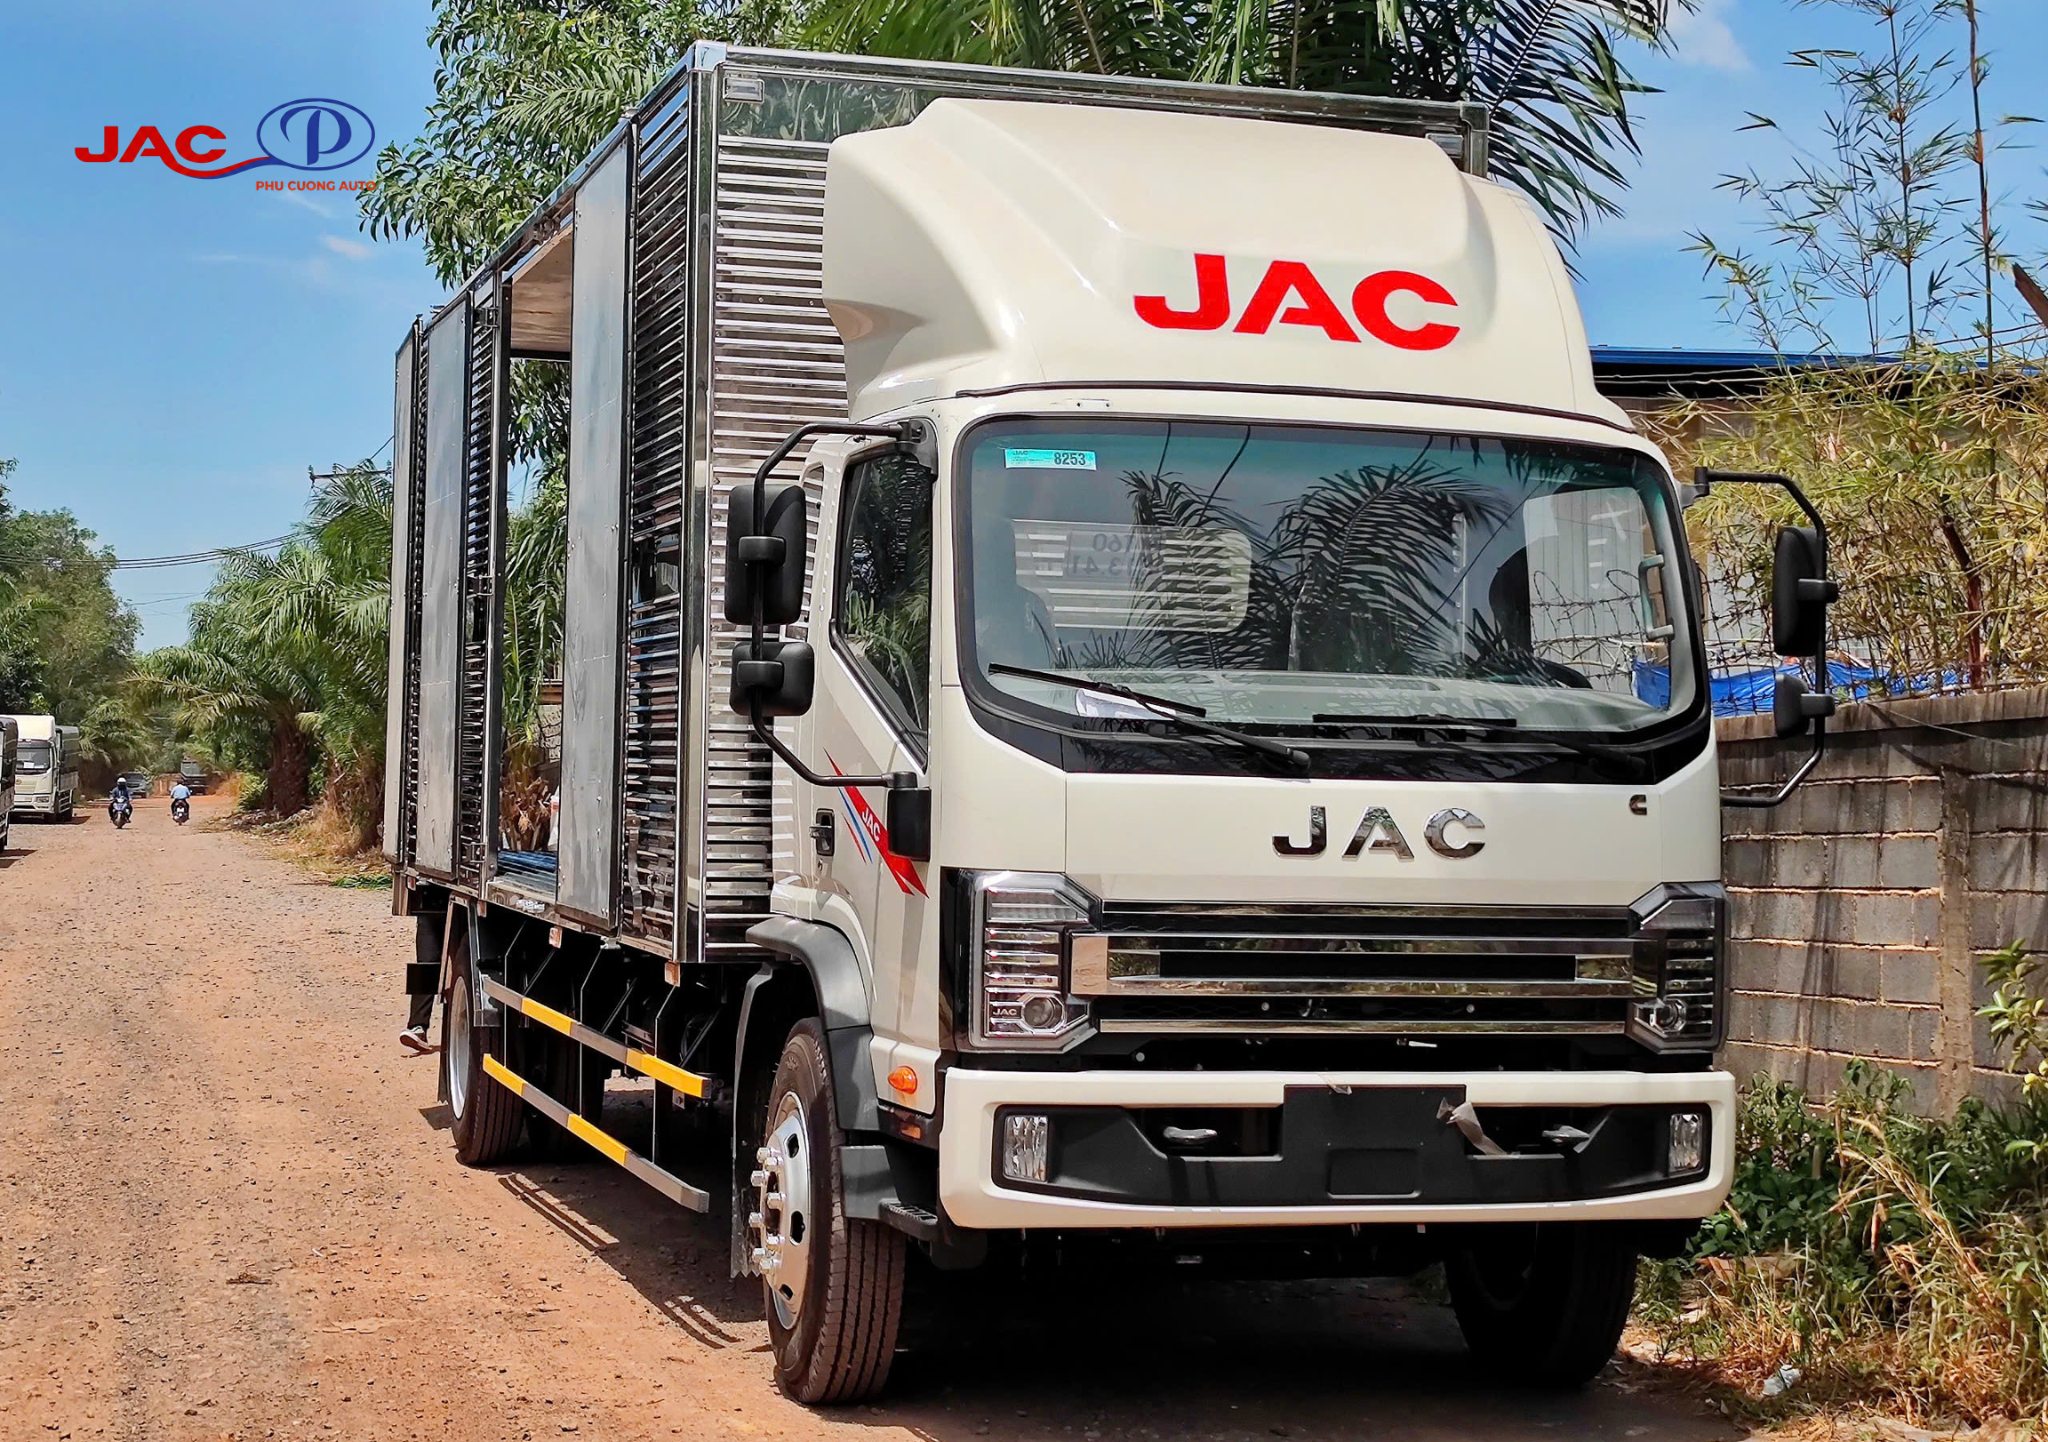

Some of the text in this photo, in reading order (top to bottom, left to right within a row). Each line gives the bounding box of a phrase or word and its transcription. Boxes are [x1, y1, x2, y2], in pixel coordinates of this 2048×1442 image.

[1133, 252, 1461, 351] JAC
[1054, 451, 1086, 466] 8253
[861, 806, 881, 842] JAC
[1272, 805, 1486, 861] JAC
[992, 1008, 1018, 1016] JAC
